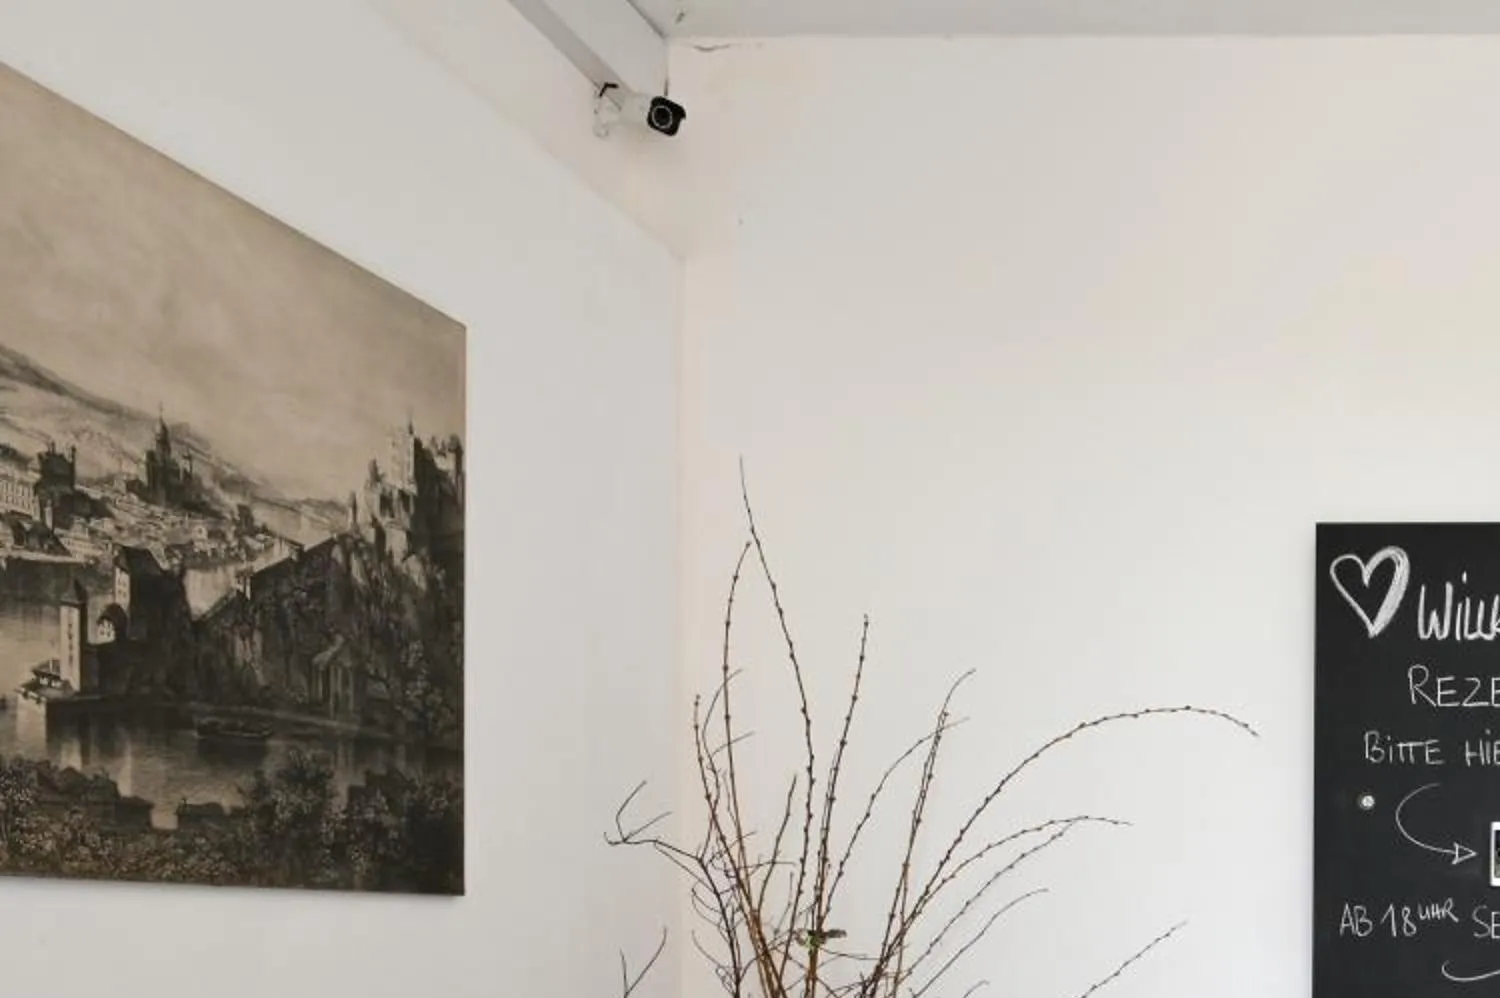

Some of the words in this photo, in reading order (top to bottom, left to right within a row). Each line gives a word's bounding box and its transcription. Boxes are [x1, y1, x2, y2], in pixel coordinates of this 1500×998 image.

[1339, 903, 1374, 938] AB
[1380, 904, 1417, 938] 18
[1418, 898, 1459, 923] UHR
